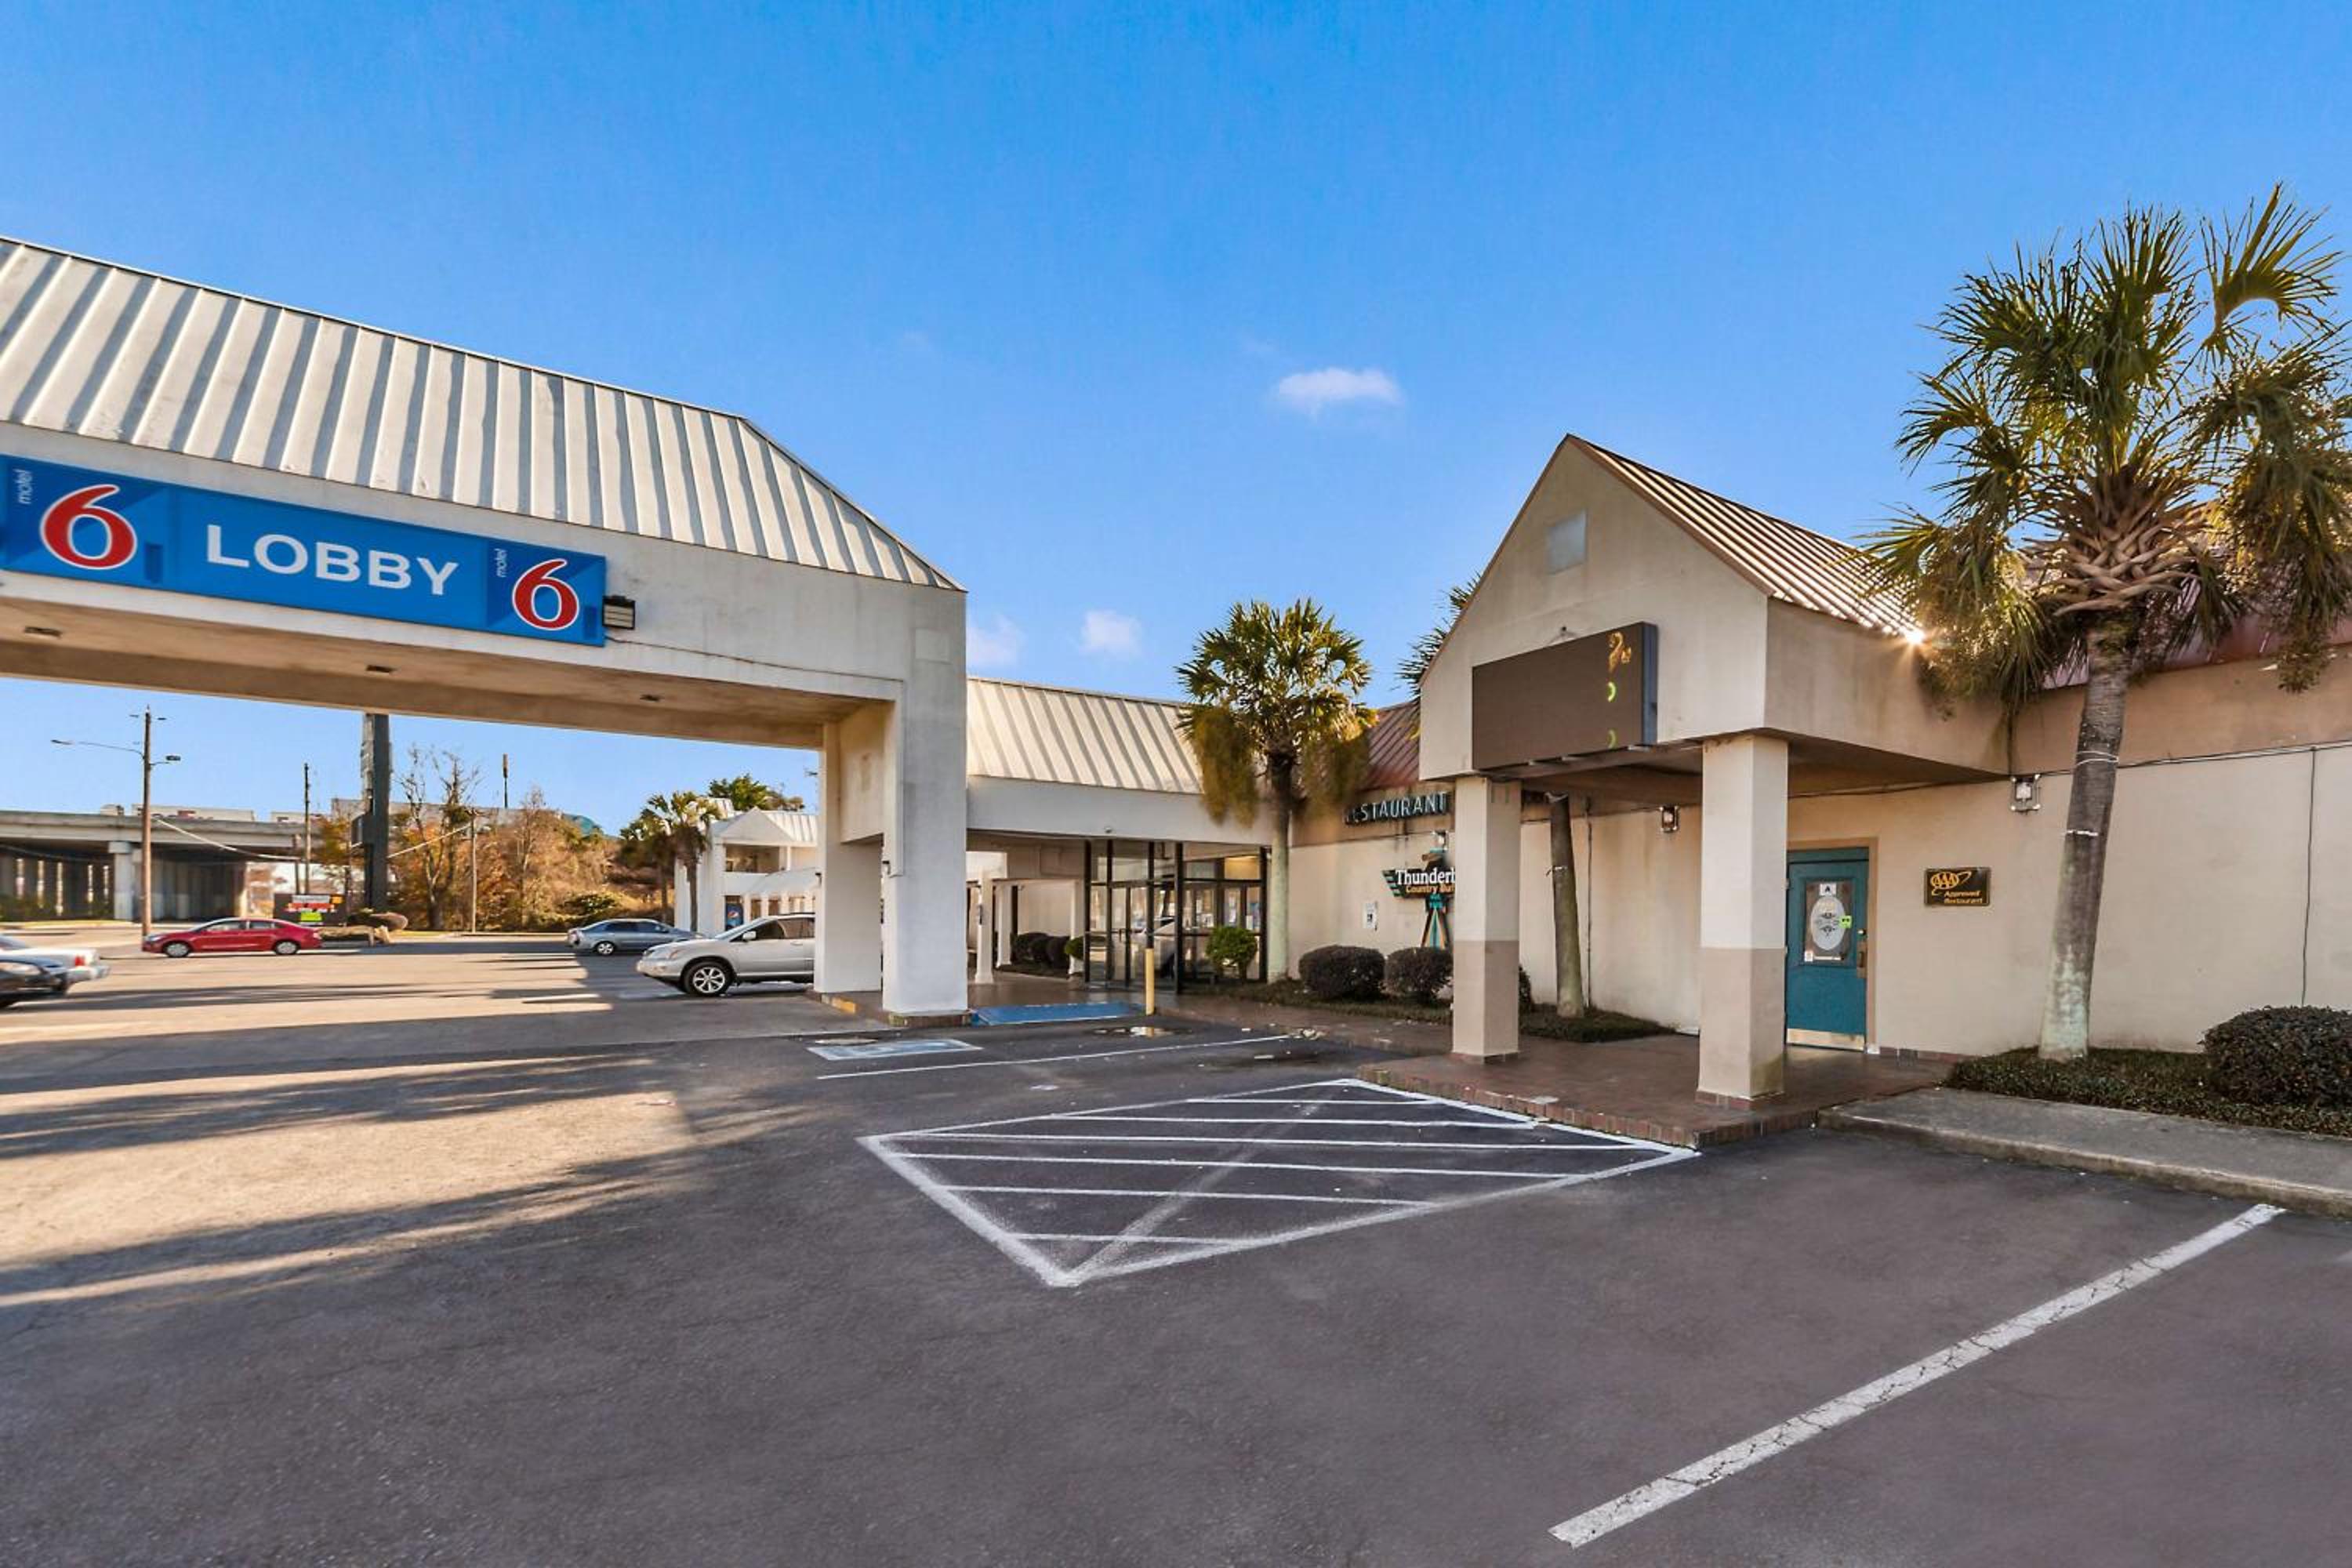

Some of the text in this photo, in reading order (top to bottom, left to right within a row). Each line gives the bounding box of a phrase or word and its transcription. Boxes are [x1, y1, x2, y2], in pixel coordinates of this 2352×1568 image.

[13, 468, 137, 570] motel 6
[206, 524, 459, 596] LOBBY
[512, 558, 579, 631] 6
[1405, 885, 1439, 895] Country
[1931, 872, 1959, 889] AAA
